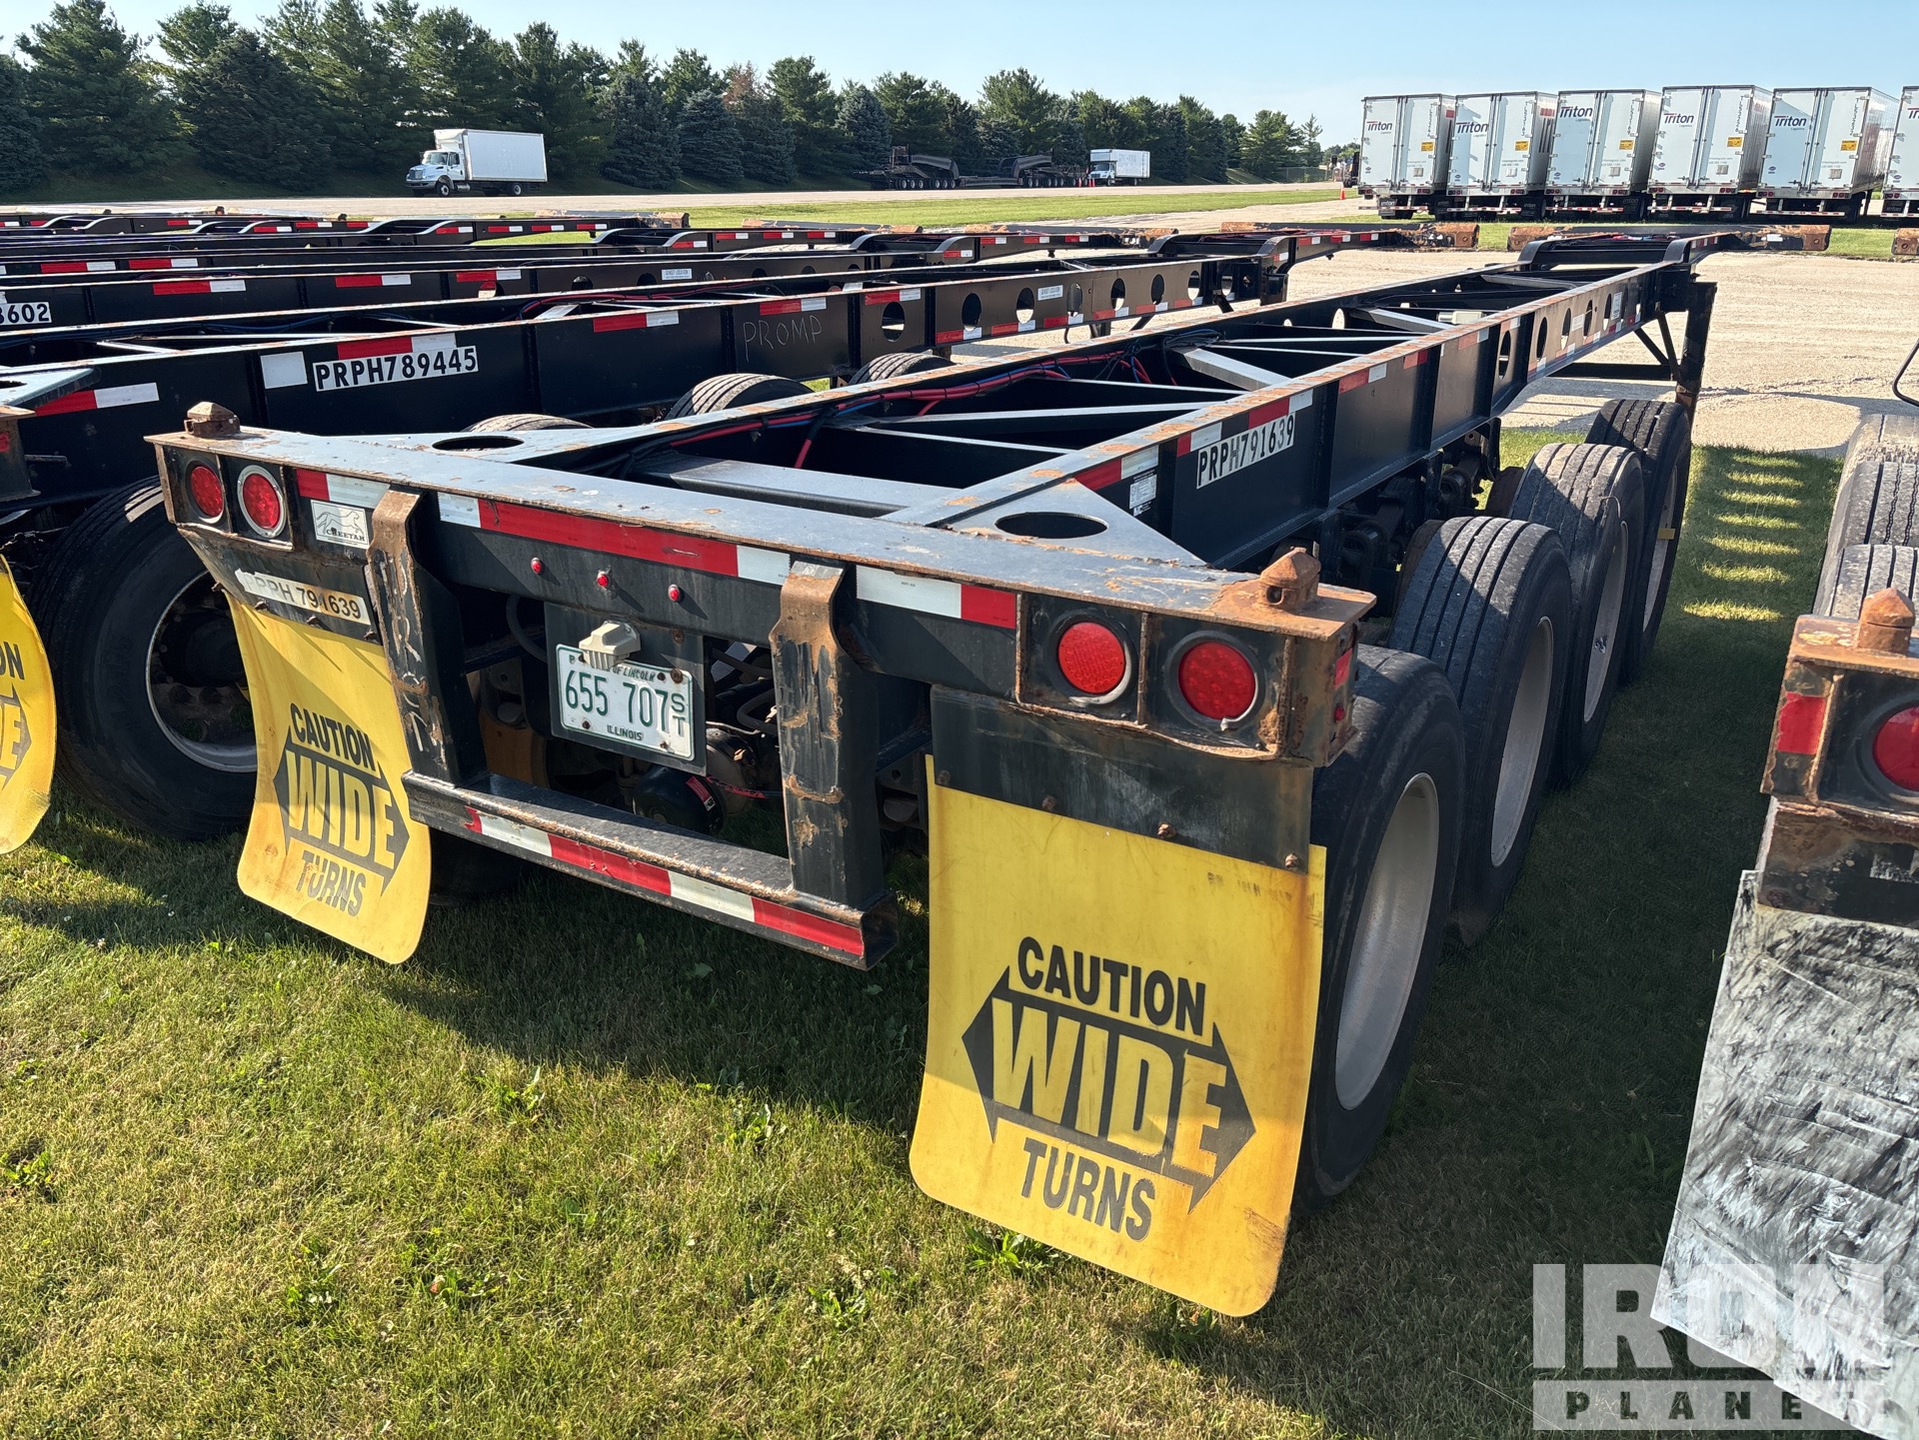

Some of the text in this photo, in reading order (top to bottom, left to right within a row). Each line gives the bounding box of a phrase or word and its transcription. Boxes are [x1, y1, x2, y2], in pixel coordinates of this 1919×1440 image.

[1366, 120, 1393, 132] Triton
[1455, 121, 1489, 134] Triton
[1560, 105, 1593, 118] Triton
[1663, 112, 1695, 124] Triton
[1774, 115, 1807, 127] Triton
[743, 314, 823, 361] PROMP
[315, 348, 478, 390] PRPH789445
[1198, 413, 1295, 486] PRPH791639
[623, 667, 656, 682] LINCOLN
[565, 670, 669, 732] 655 707
[290, 702, 377, 772] CAUTION
[607, 724, 643, 741] ILLINOIS
[285, 750, 395, 870] WIDE
[296, 849, 367, 918] TURNS
[1017, 936, 1206, 1037] CAUTION
[991, 997, 1228, 1179] WIDE
[1020, 1137, 1156, 1242] TURNS
